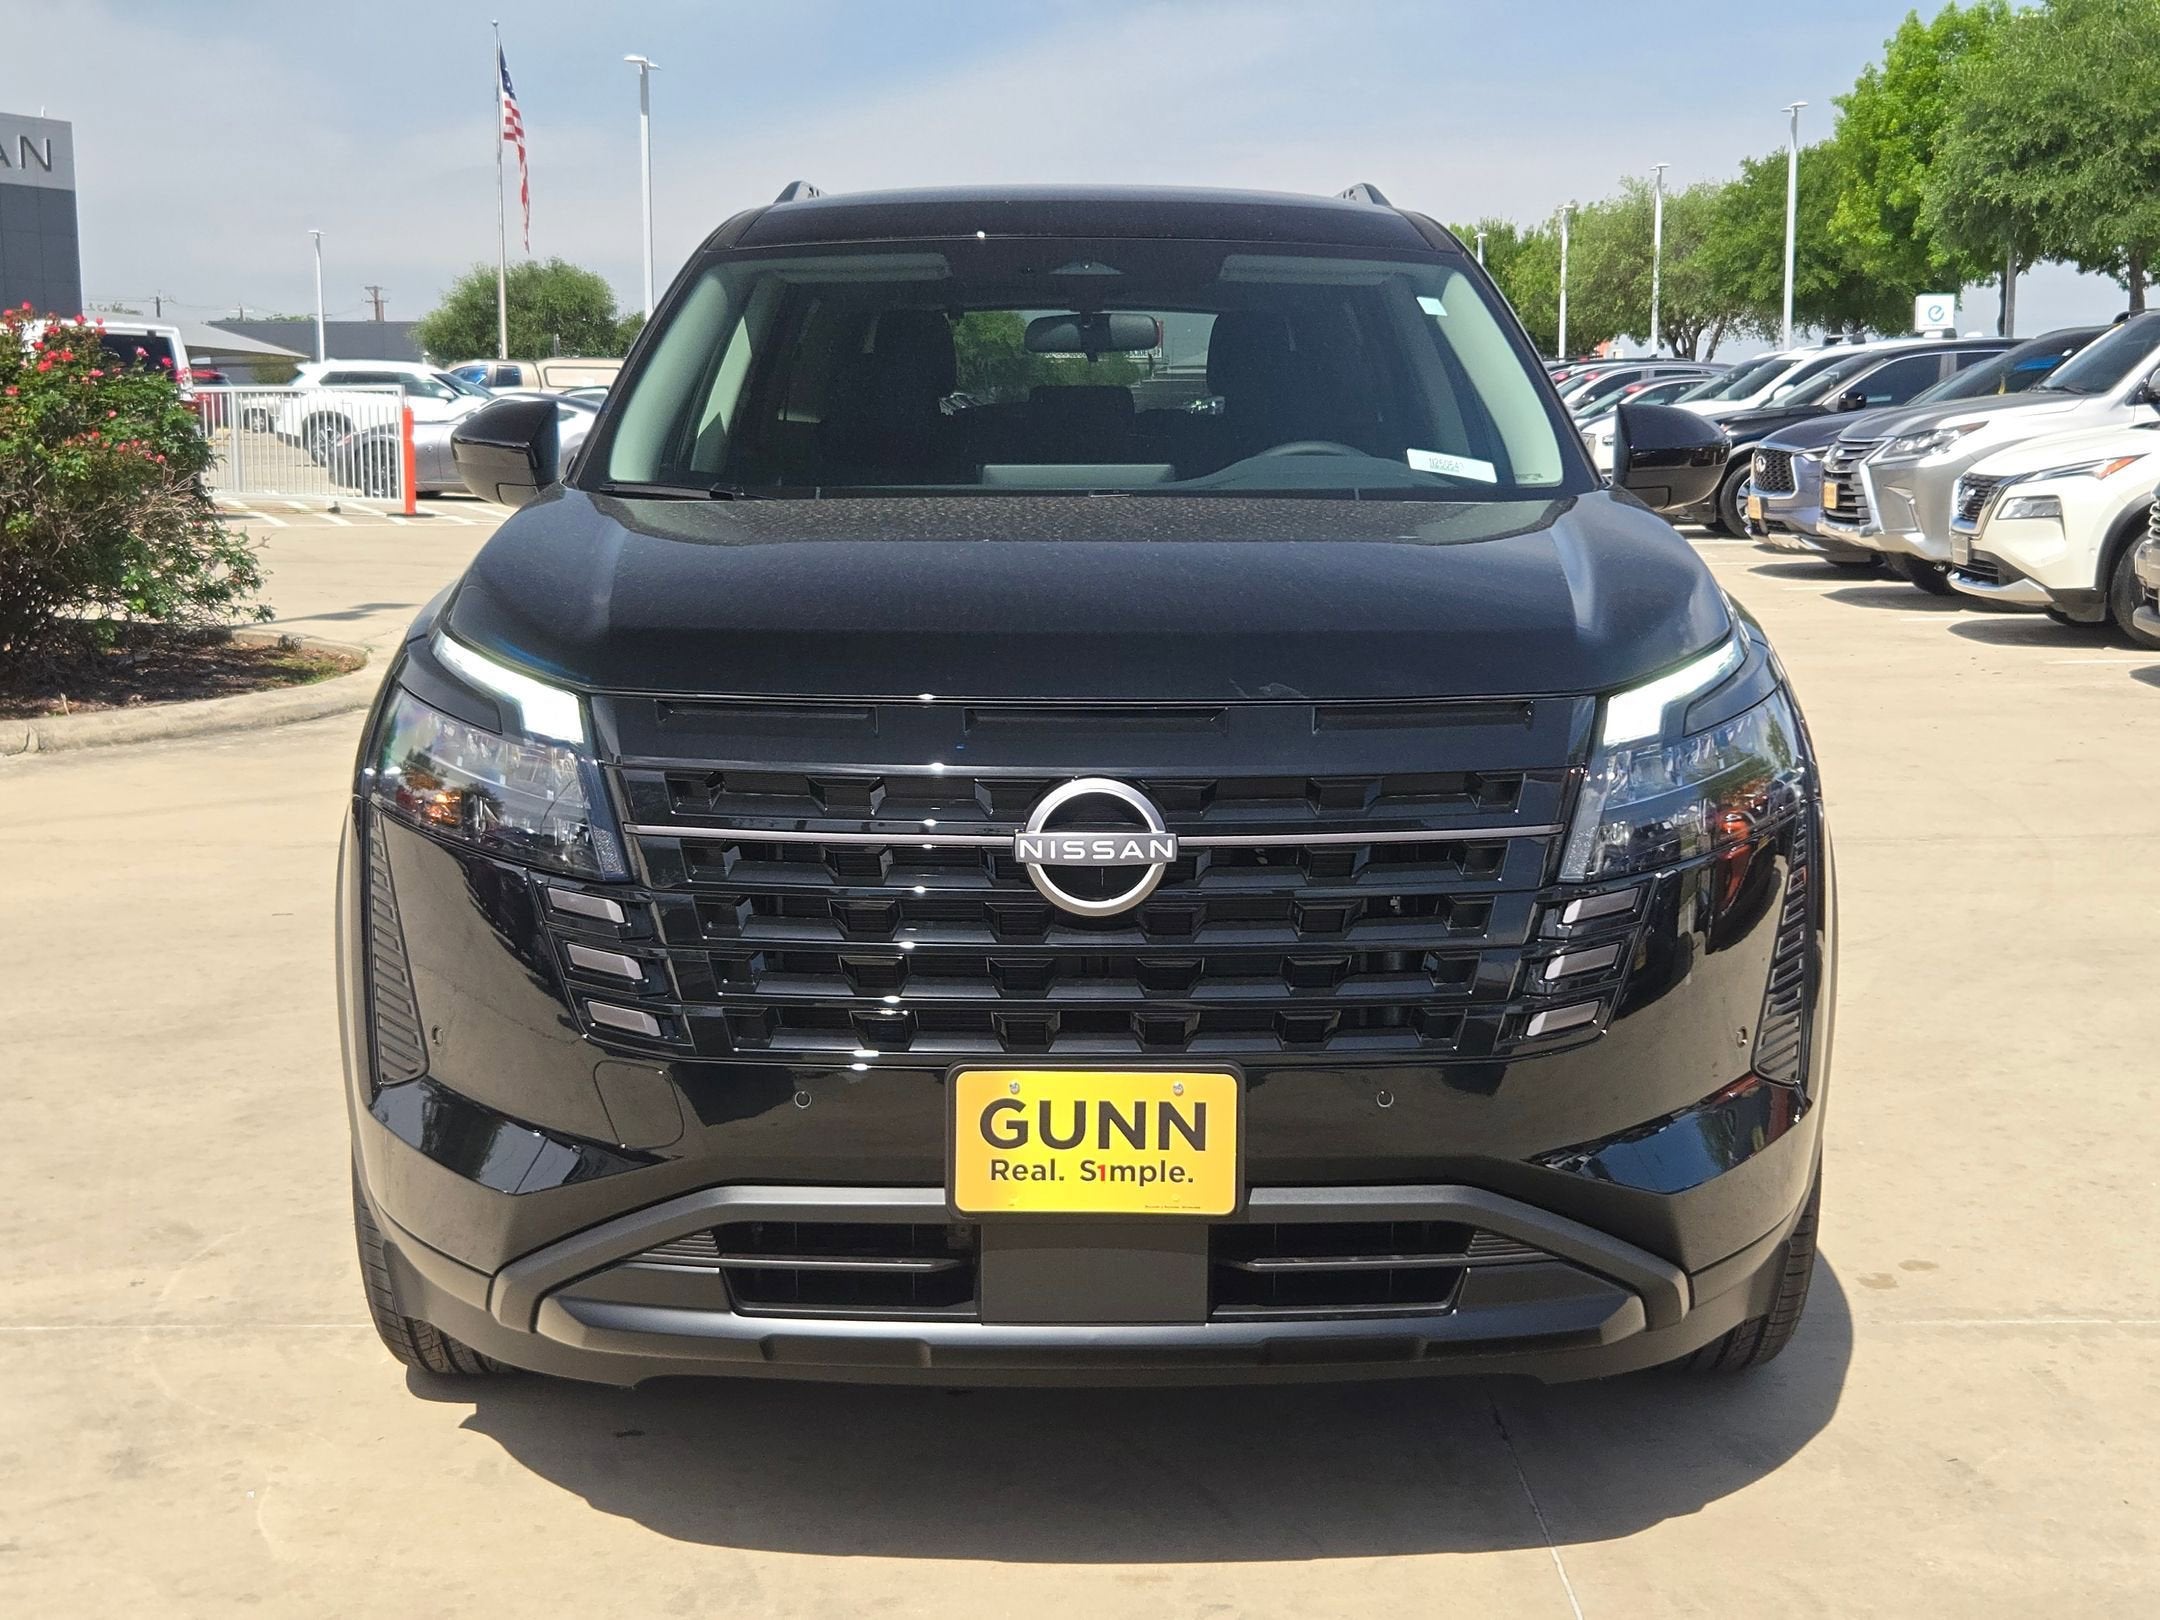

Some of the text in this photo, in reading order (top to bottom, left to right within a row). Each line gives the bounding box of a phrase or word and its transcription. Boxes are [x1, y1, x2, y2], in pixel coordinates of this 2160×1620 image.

[1018, 838, 1174, 860] NISSAN
[979, 1097, 1207, 1152] GUNN
[990, 1158, 1065, 1182] Real.
